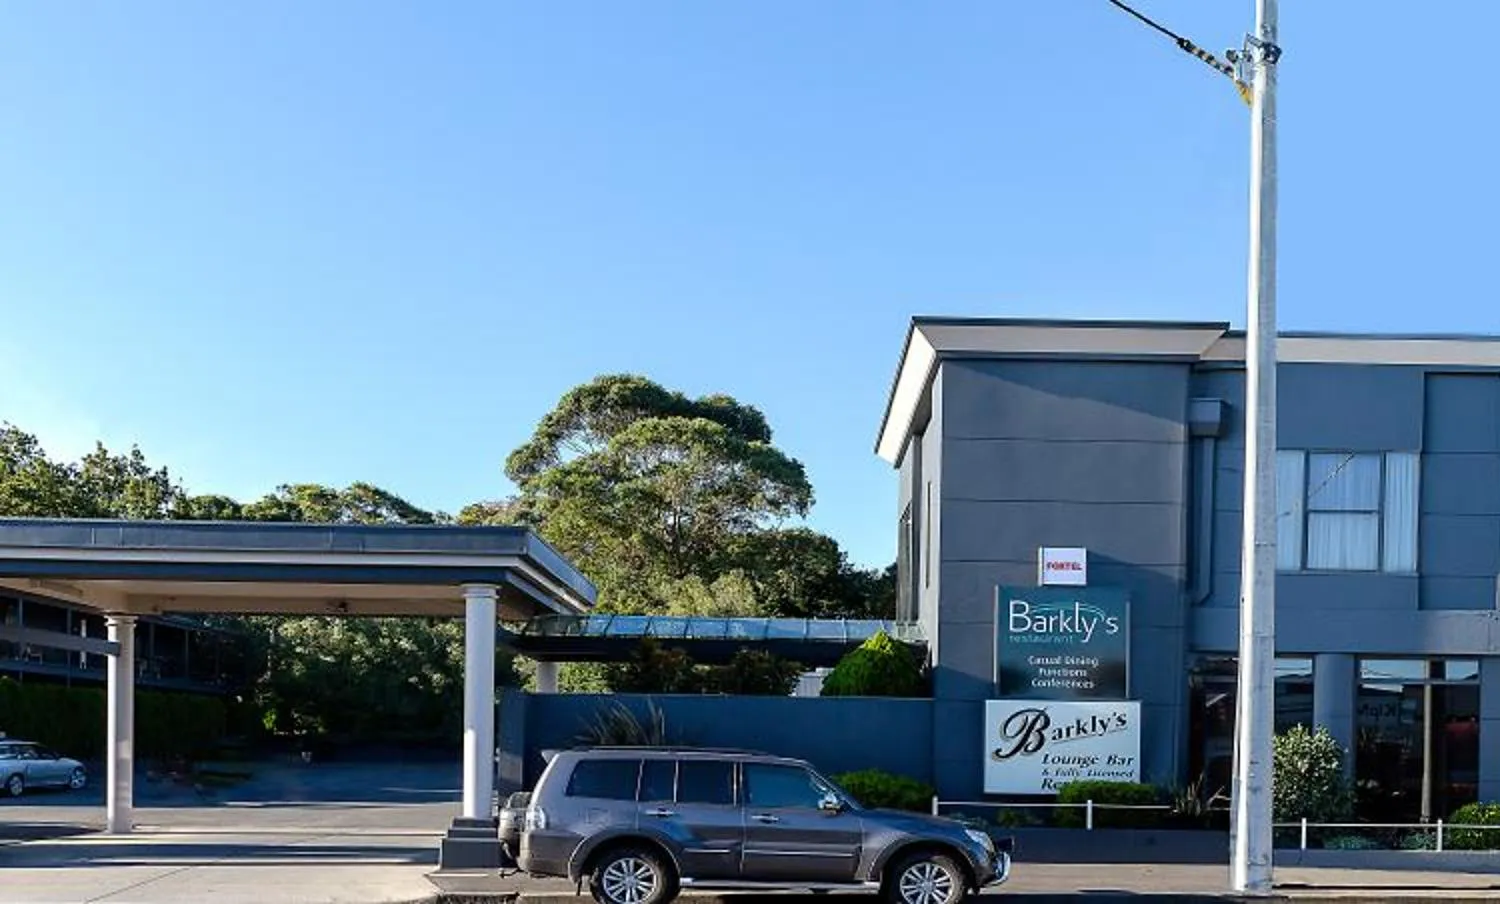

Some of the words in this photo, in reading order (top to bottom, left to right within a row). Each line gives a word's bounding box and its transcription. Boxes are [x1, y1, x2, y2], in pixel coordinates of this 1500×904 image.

[1009, 600, 1119, 643] Barkly's
[993, 706, 1128, 763] Barkly's
[1041, 753, 1099, 768] Lounge
[1106, 754, 1134, 766] Bar
